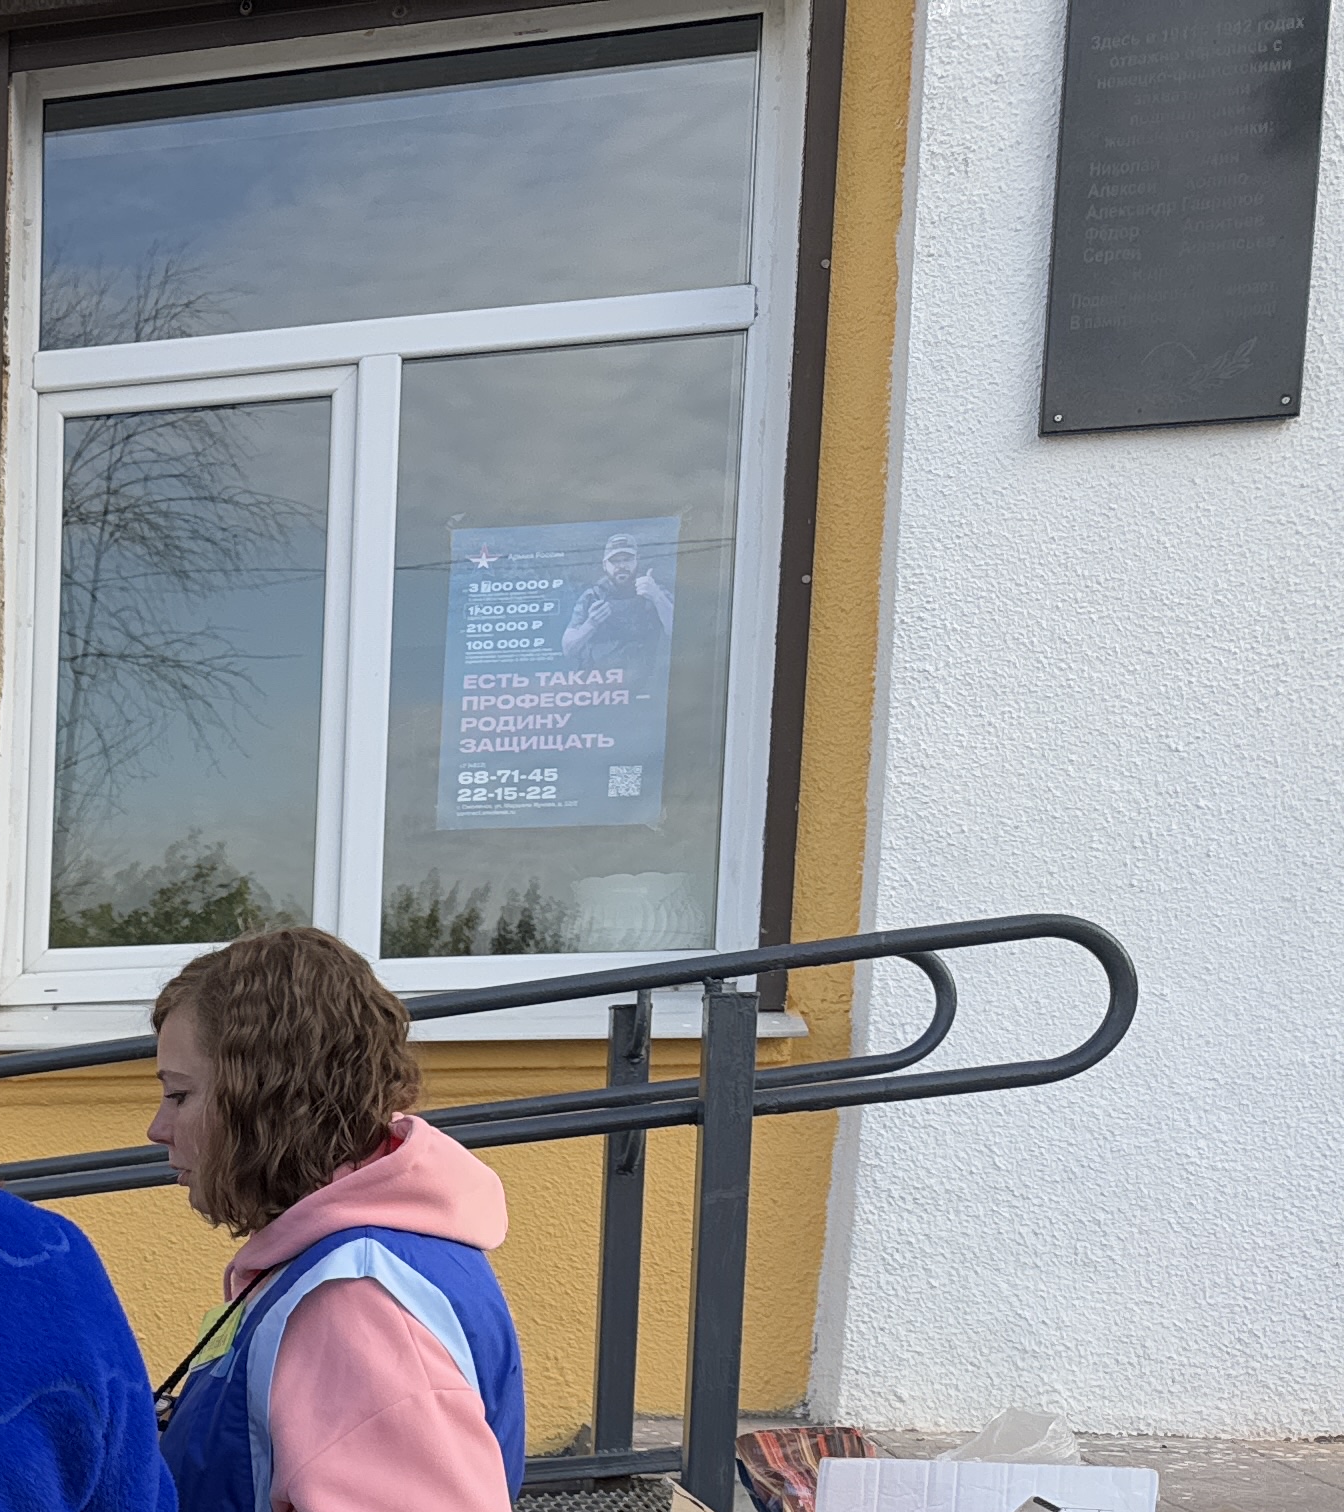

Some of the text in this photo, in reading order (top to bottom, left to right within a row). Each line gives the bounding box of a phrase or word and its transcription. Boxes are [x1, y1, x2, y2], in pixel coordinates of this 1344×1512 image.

[468, 583, 479, 593] 3
[515, 579, 549, 591] 000
[466, 623, 493, 633] 210
[495, 621, 528, 632] 000
[465, 640, 494, 650] 100
[497, 638, 530, 649] 000
[463, 668, 624, 690] ЕСТЬ ТАКАЯ
[461, 690, 629, 712] ПРОФЕССИЯ
[460, 713, 572, 733] РОДИНУ
[459, 733, 615, 754] ЗАЩИЩАТЬ
[458, 768, 558, 785] 68-71-45
[456, 785, 557, 803] 22-15-22
